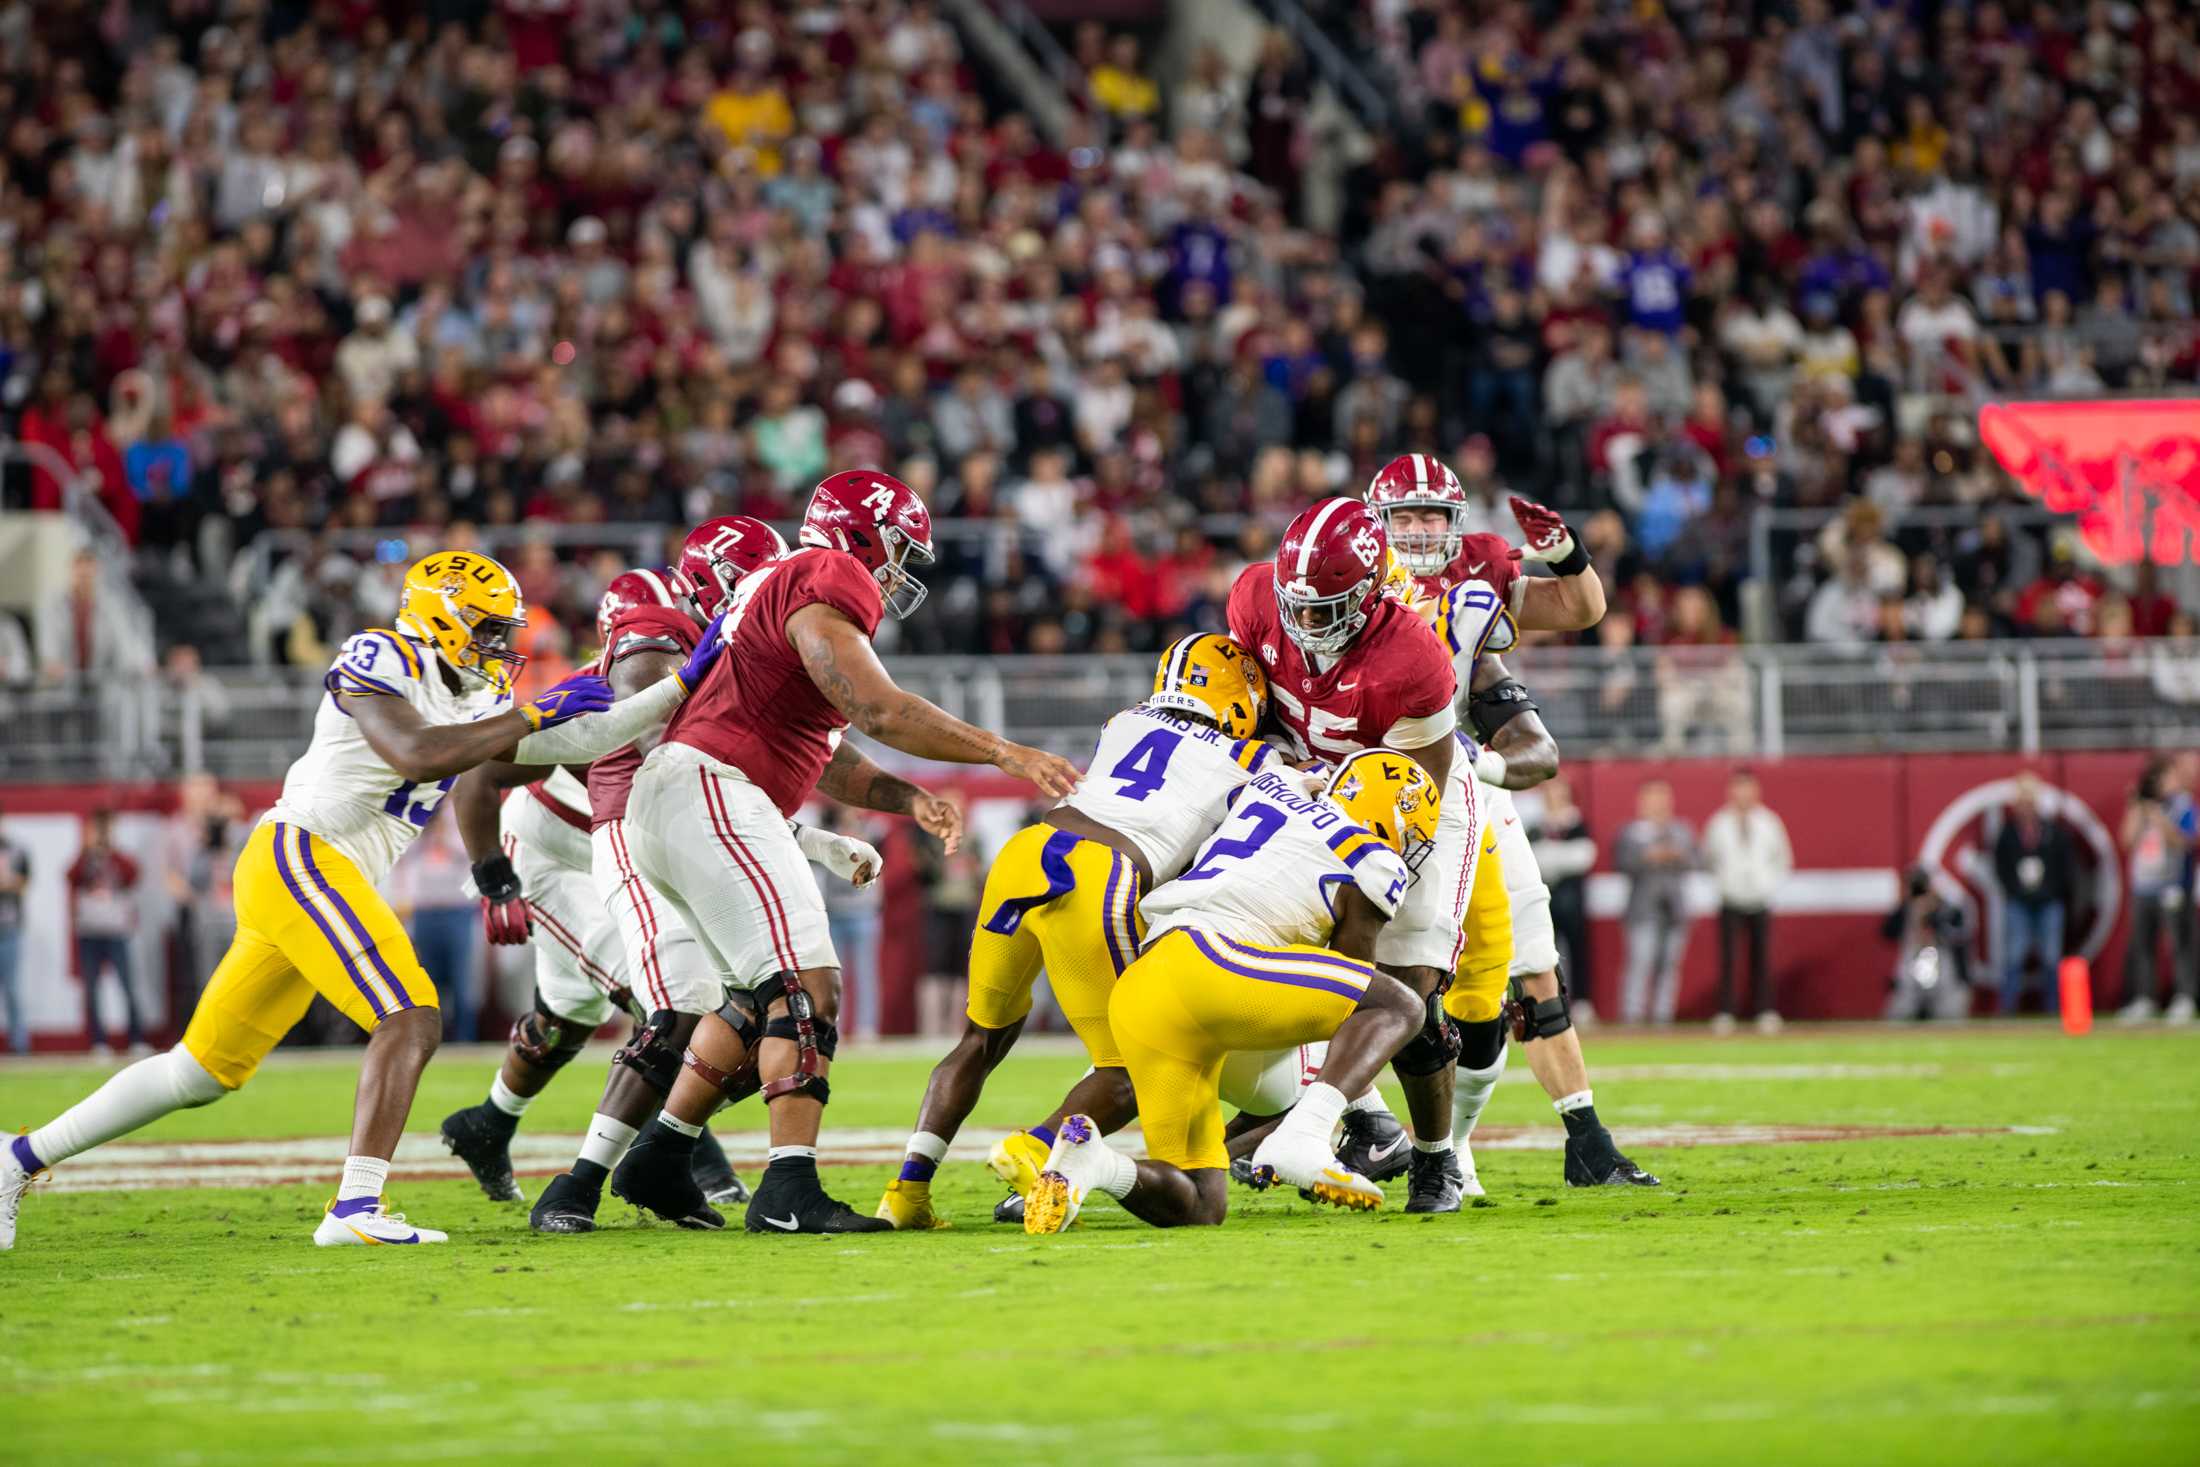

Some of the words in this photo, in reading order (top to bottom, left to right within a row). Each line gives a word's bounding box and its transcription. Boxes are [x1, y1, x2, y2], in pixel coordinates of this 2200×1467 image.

[860, 482, 896, 516] 74
[704, 525, 744, 555] 77
[1351, 526, 1380, 567] 65
[424, 556, 495, 584] LSU
[351, 639, 380, 672] 13
[1152, 696, 1195, 707] TIGERS
[1193, 727, 1223, 747] JR.
[1110, 728, 1185, 801] 4
[1382, 761, 1438, 807] LSU
[383, 773, 459, 828] 13
[1250, 772, 1340, 830] OGHOUFO
[1178, 801, 1288, 881] 2
[1384, 867, 1407, 907] 2
